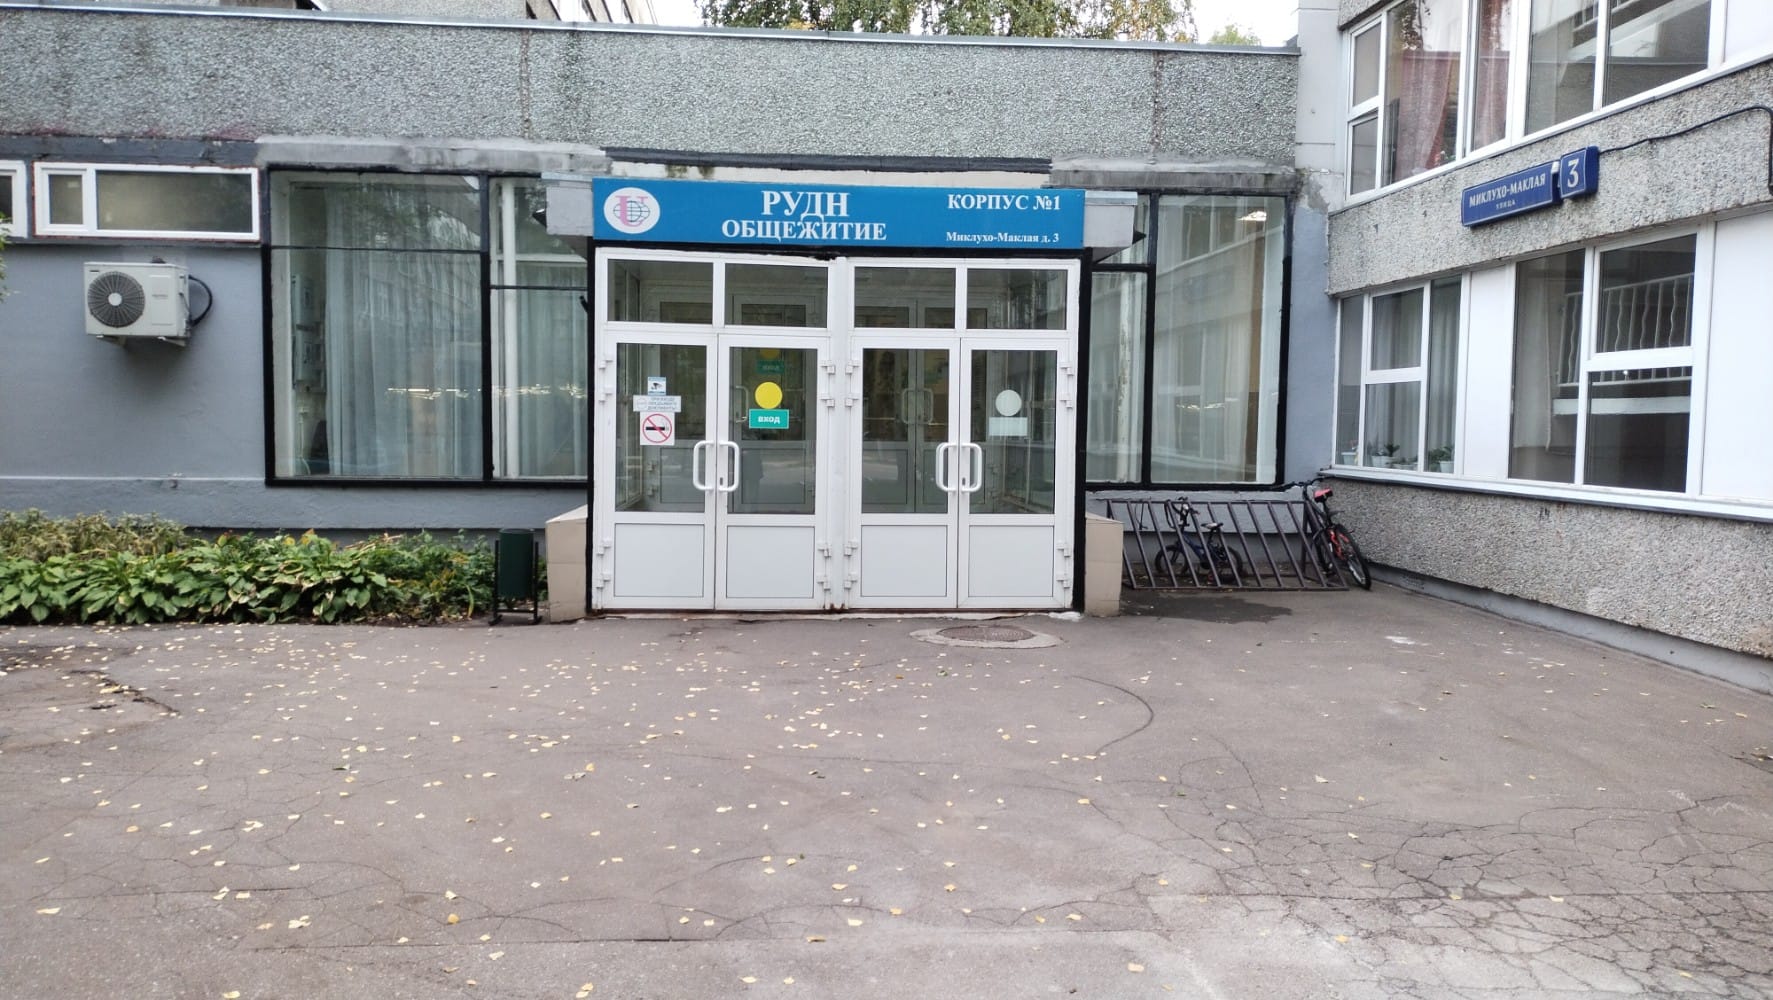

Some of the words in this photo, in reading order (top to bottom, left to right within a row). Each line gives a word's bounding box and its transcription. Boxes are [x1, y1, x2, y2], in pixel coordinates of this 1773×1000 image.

[1567, 158, 1580, 188] 3
[948, 194, 1029, 210] КОРПУС
[1033, 195, 1060, 210] №1
[1469, 173, 1546, 208] МИКЛУХО-МАКЛАЯ
[761, 190, 850, 222] РУДН
[721, 219, 887, 242] ОБЩЕЖИТИЕ
[946, 231, 1039, 244] Миклухо-Маклая
[1041, 234, 1051, 243] д.
[1053, 233, 1060, 243] 3
